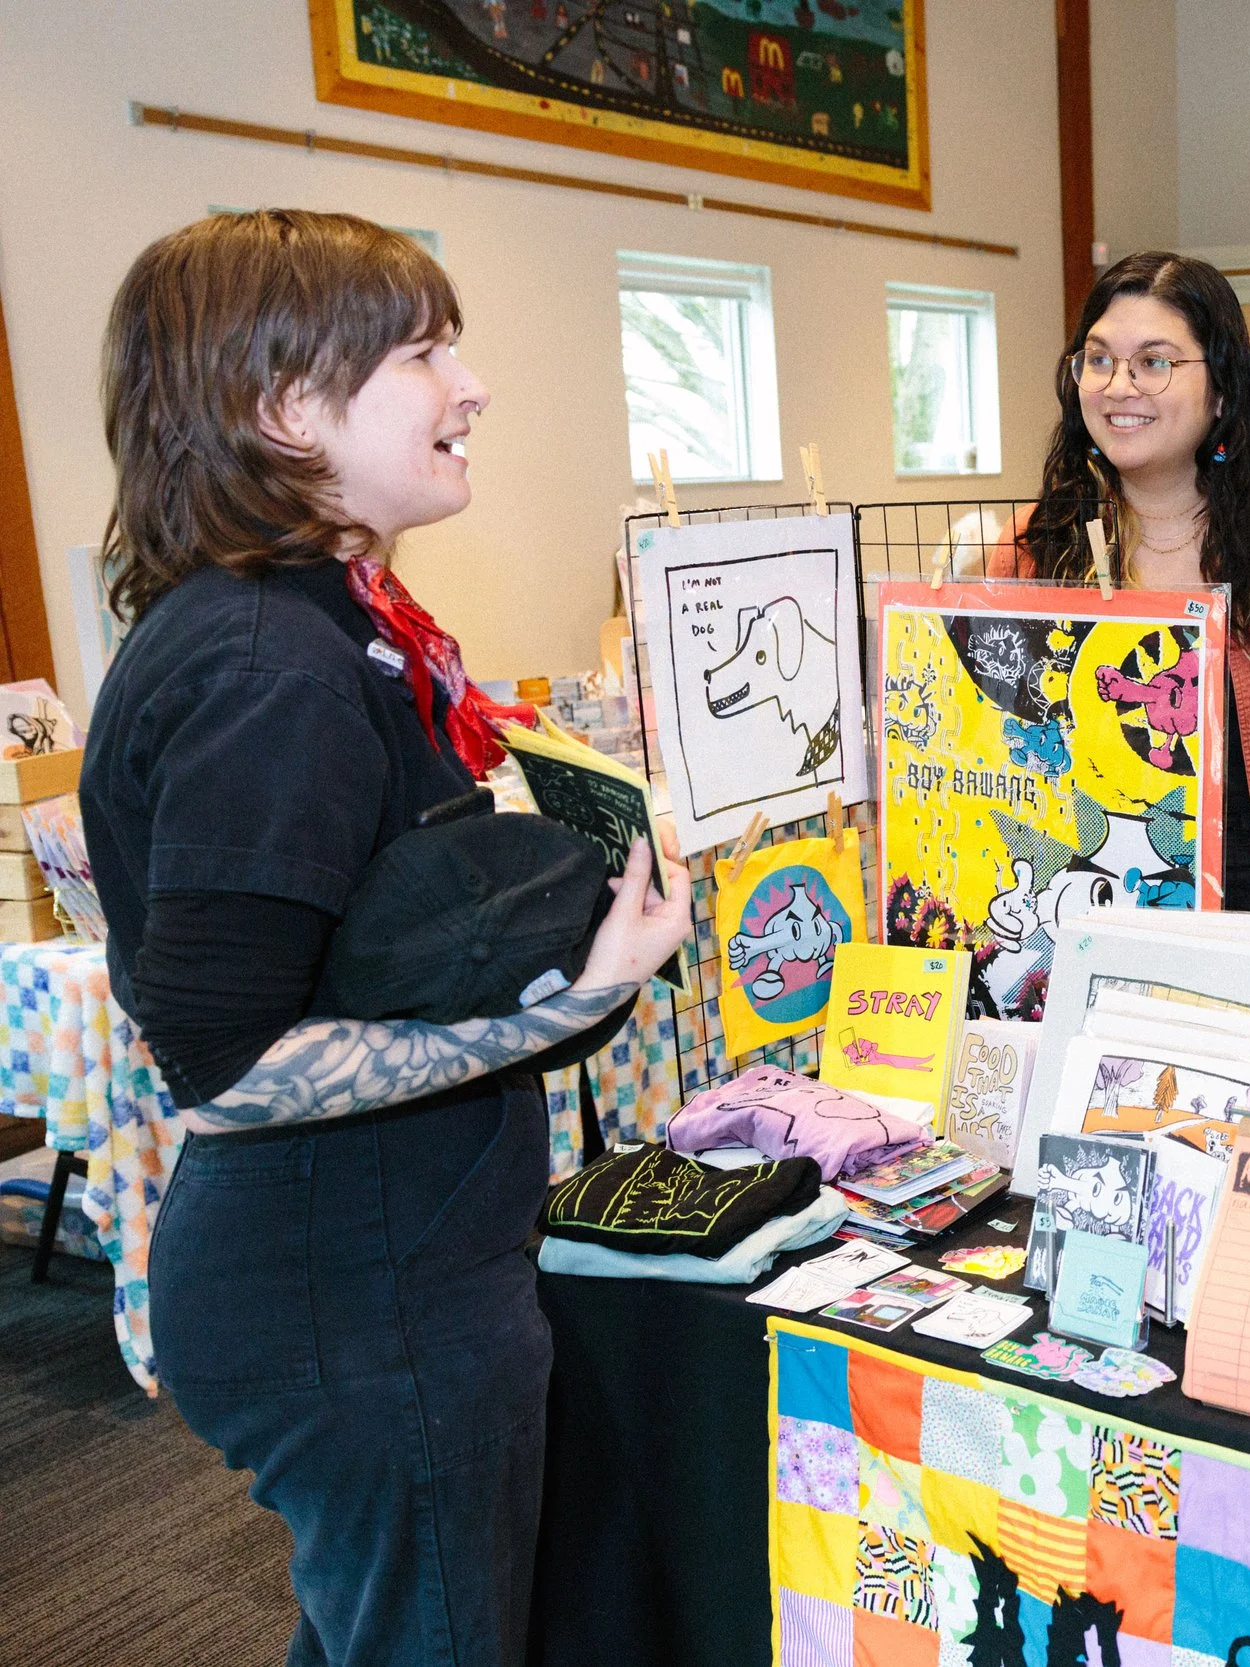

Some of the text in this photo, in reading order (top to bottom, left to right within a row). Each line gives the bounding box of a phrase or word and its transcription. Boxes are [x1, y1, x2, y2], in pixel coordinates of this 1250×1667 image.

[682, 576, 722, 590] I'M NOT
[681, 599, 724, 614] A REAL
[1188, 601, 1204, 613] $50
[692, 623, 715, 637] DOG
[952, 768, 1037, 804] BAWANG
[929, 960, 944, 971] $20
[847, 989, 943, 1021] STRAY
[958, 1032, 1018, 1085] FOOD
[967, 1067, 1014, 1104] THAT
[951, 1084, 979, 1121] IS
